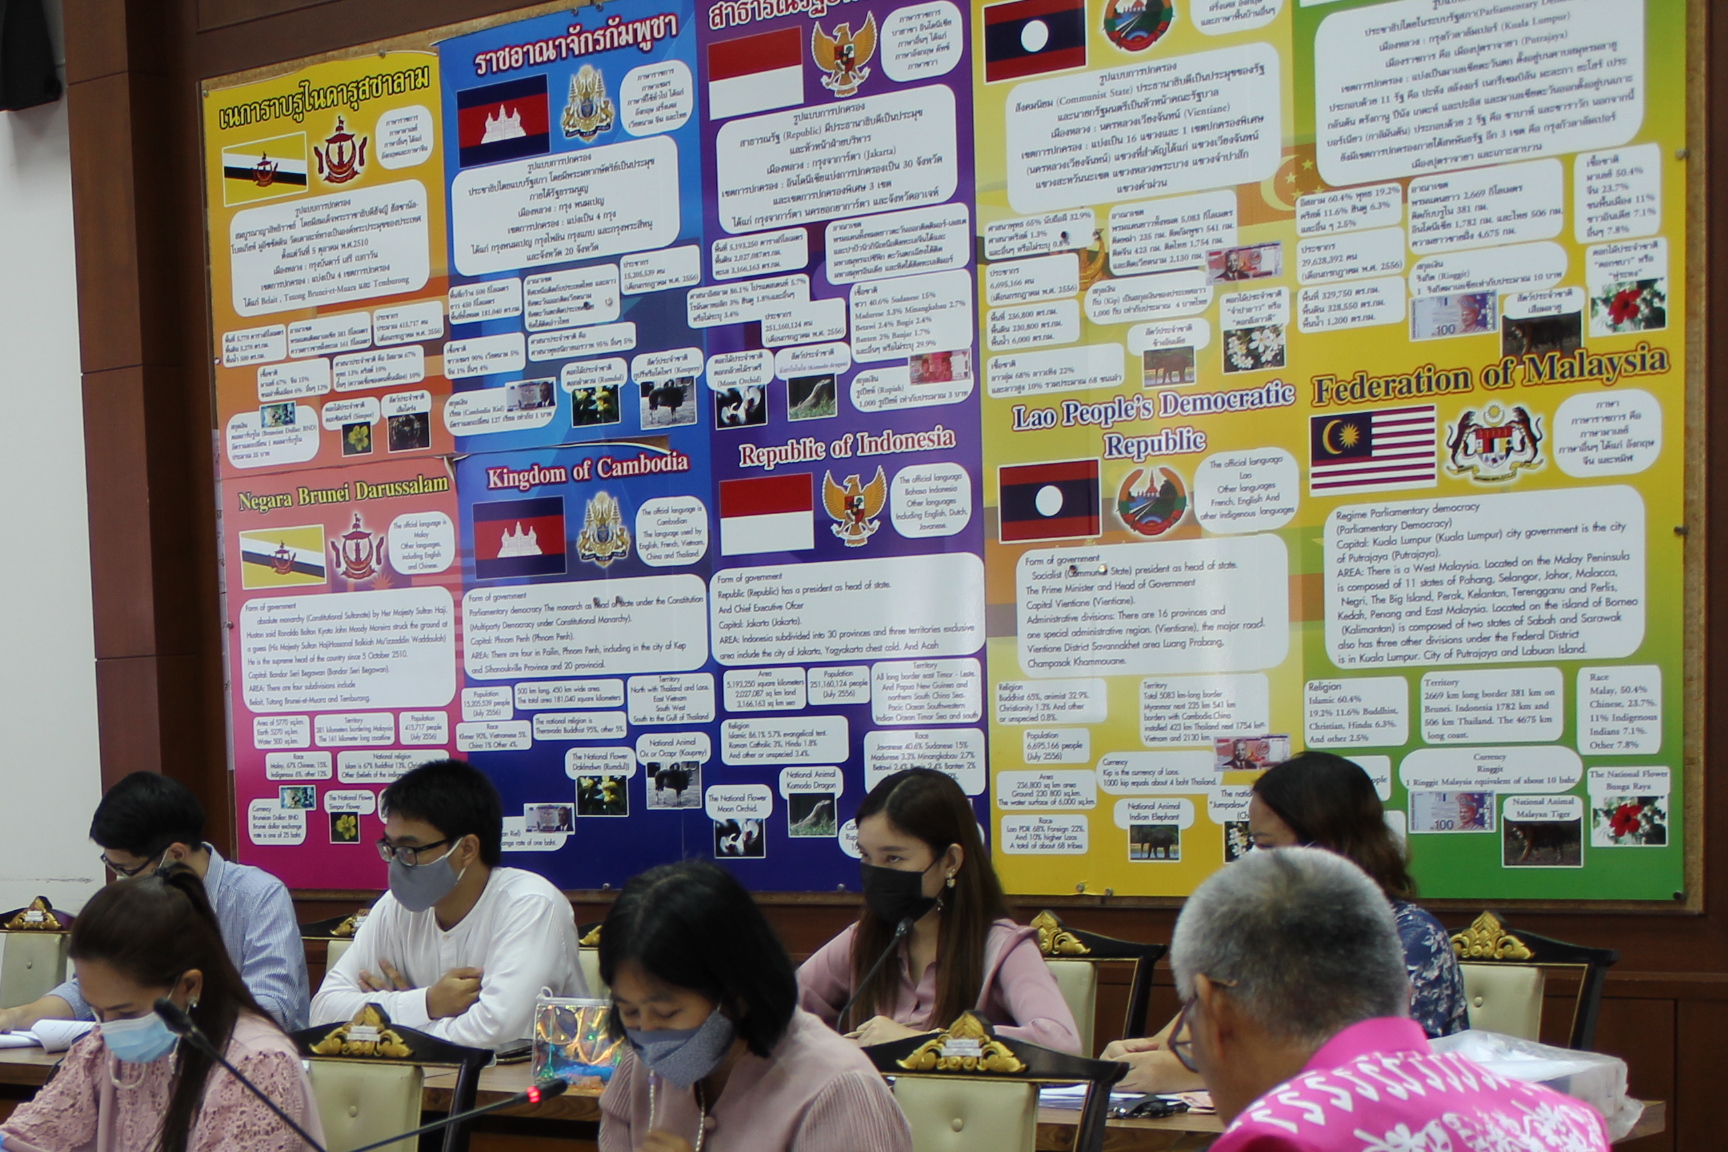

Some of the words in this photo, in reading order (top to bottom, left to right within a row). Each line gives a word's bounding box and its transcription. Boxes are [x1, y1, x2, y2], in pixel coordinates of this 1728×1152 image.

[475, 14, 678, 75] ราชอาณาจักรกัมพูชา
[1313, 366, 1470, 405] Federation
[1482, 361, 1515, 388] of
[1523, 342, 1668, 389] Malaysia
[1013, 407, 1056, 430] Lao
[1160, 381, 1295, 416] Democratic
[739, 438, 825, 468] Republic
[832, 434, 853, 458] of
[857, 426, 955, 455] Indonesia
[1104, 428, 1206, 461] Republic
[488, 465, 566, 490] Kingdom
[573, 462, 591, 480] of
[597, 453, 688, 478] Cambodia
[239, 493, 292, 512] Negara
[298, 484, 349, 506] Brunei
[355, 475, 448, 500] Darussalam
[1336, 510, 1367, 522] Regime
[1370, 506, 1429, 517] Parliamentary
[1432, 503, 1480, 513] democracy
[1336, 522, 1398, 535] (Parliamentary
[1400, 517, 1452, 530] Democracy)
[1372, 535, 1397, 546] Kuala
[1400, 535, 1432, 546] Lumpur
[1435, 530, 1464, 543] (Kuala
[1466, 528, 1502, 542] Lumpur)
[1505, 527, 1522, 539] city
[1524, 524, 1578, 539] government
[1581, 523, 1589, 533] is
[1592, 522, 1606, 532] the
[1609, 521, 1626, 533] city
[1025, 557, 1044, 566] Form
[1046, 554, 1054, 565] of
[1056, 553, 1100, 567] government
[1336, 552, 1346, 563] of
[1348, 552, 1388, 564] Putrajaya
[1366, 565, 1390, 575] There
[1394, 565, 1400, 574] is
[1412, 563, 1436, 572] West
[1484, 556, 1518, 568] Located
[1536, 555, 1551, 565] the
[1553, 553, 1583, 565] Malay
[1586, 550, 1630, 562] Peninsula
[717, 575, 734, 583] Form
[735, 573, 743, 582] of
[744, 572, 782, 584] government
[1025, 585, 1039, 595] The
[1041, 585, 1062, 594] Prime
[1064, 583, 1094, 592] Minister
[1096, 580, 1112, 591] and
[1114, 579, 1135, 590] Head
[1137, 578, 1146, 589] of
[1148, 578, 1196, 588] Government
[1337, 583, 1344, 592] is
[1346, 578, 1390, 593] composed
[1392, 577, 1402, 589] of
[1406, 578, 1415, 587] 11
[1420, 578, 1444, 587] states
[1446, 574, 1456, 585] of
[1498, 572, 1541, 584] Selangor,
[1544, 569, 1572, 580] Johor,
[1575, 567, 1618, 582] Malacca,
[1370, 609, 1402, 620] Penang
[1404, 605, 1422, 617] and
[1425, 606, 1443, 616] East
[1492, 600, 1526, 612] Located
[1544, 599, 1558, 609] the
[1561, 597, 1589, 609] island
[1592, 597, 1602, 607] of
[1605, 596, 1638, 607] Borneo
[1338, 654, 1345, 664] is
[1348, 654, 1356, 663] in
[1358, 651, 1384, 662] Kuala
[1423, 649, 1441, 662] City
[1443, 648, 1453, 659] of
[1456, 648, 1498, 660] Putrajaya
[1500, 645, 1518, 656] and
[1521, 644, 1554, 655] Labuan
[1308, 681, 1342, 693] Religion
[1423, 678, 1460, 687] Territory
[1589, 673, 1609, 681] Race
[1435, 820, 1454, 830] 100
